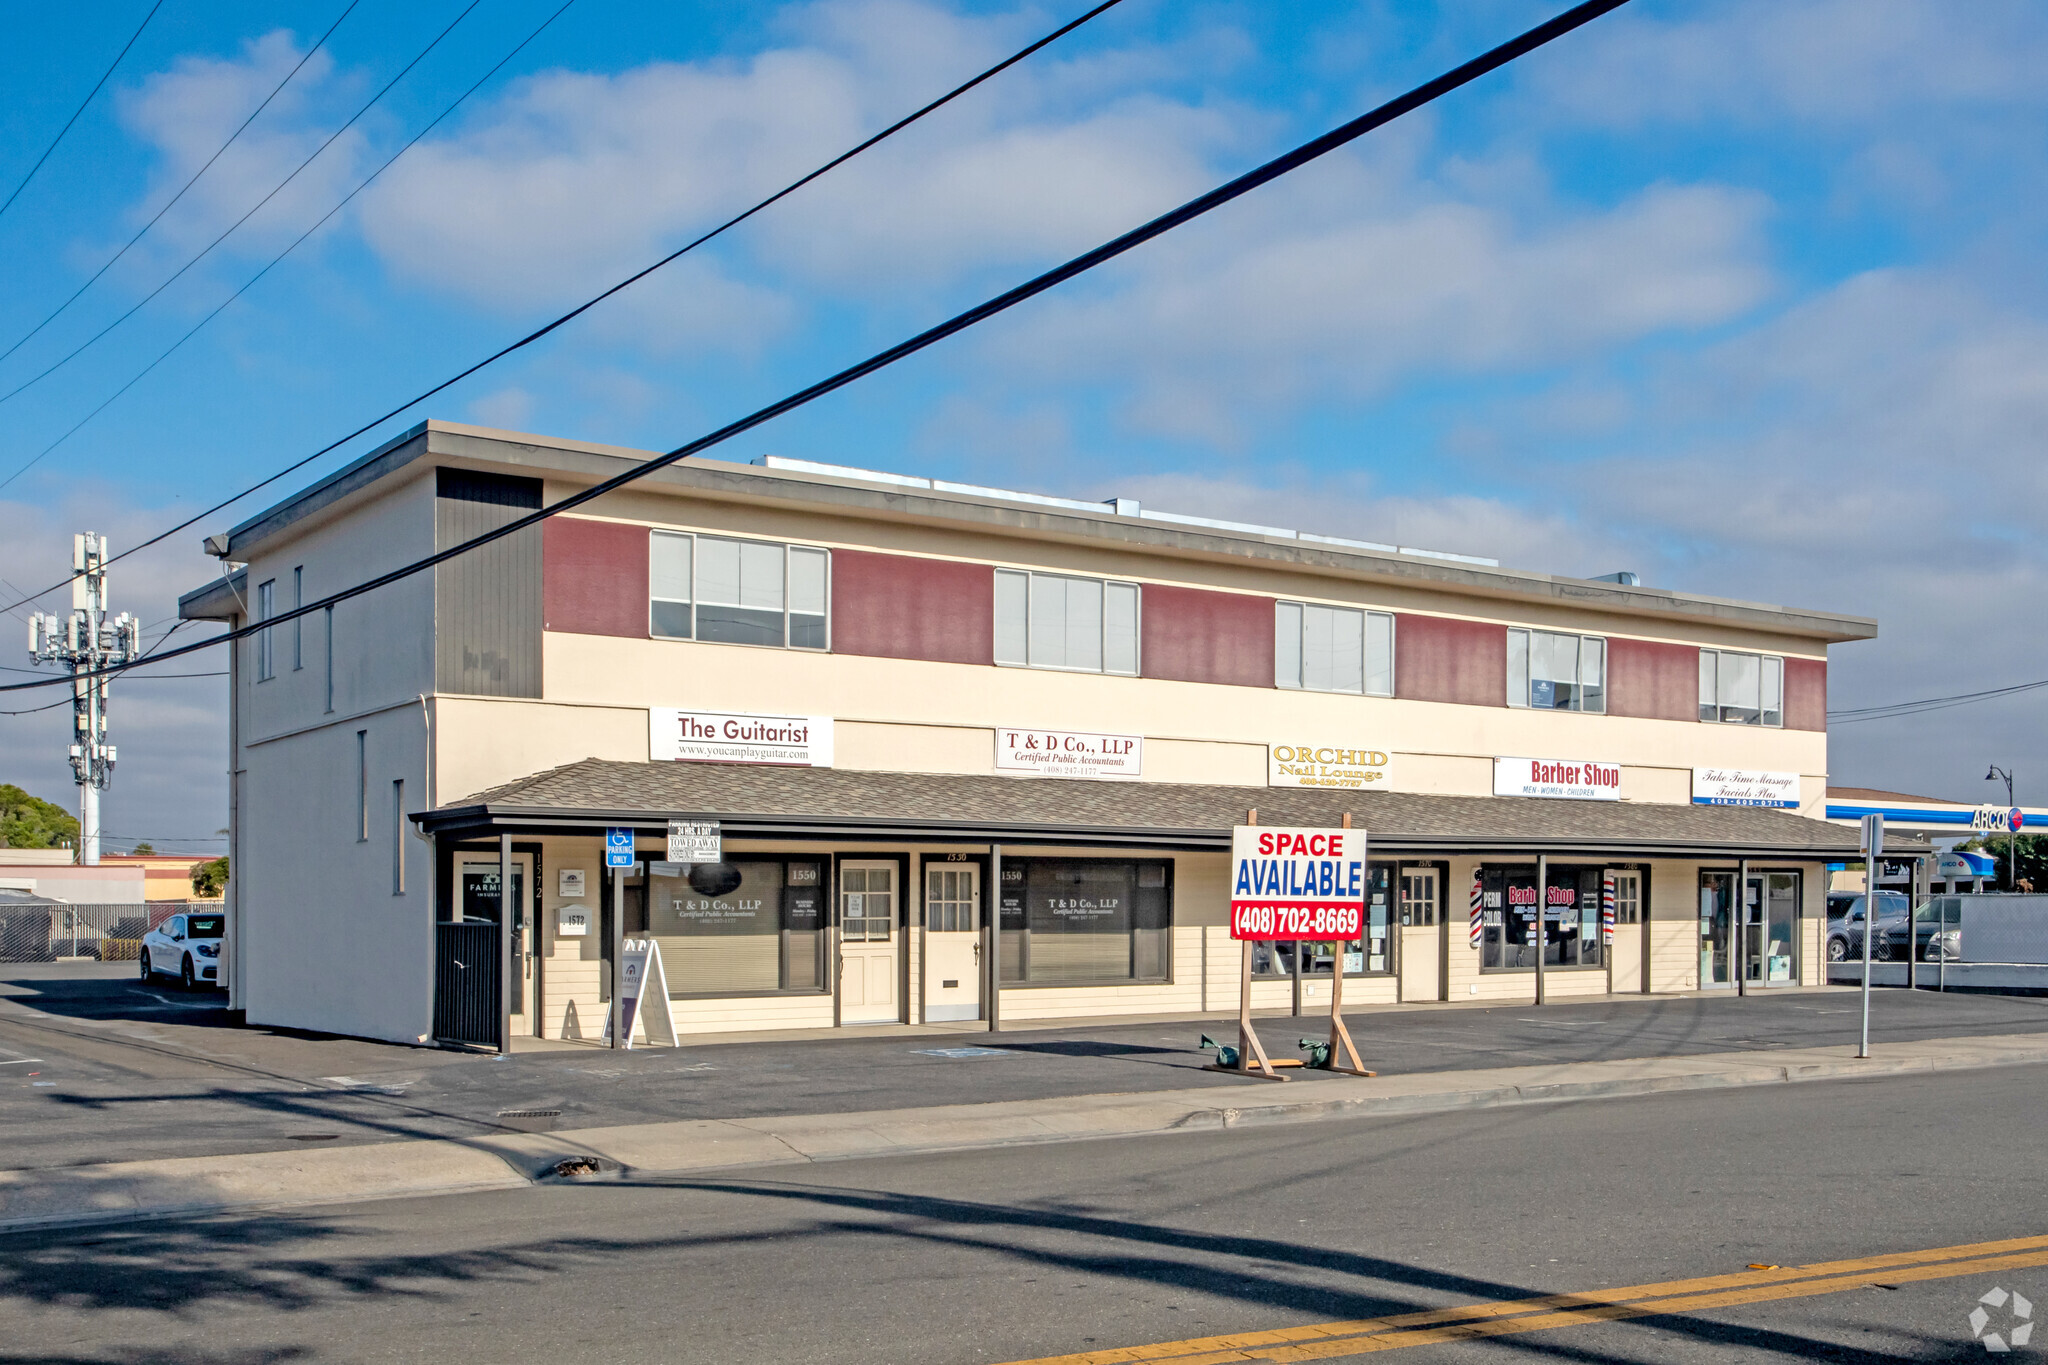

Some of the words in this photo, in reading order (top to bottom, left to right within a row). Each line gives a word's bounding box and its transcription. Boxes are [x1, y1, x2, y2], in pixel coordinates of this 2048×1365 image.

[678, 717, 716, 738] The
[723, 719, 809, 743] Guitarist
[679, 746, 808, 759] www.youcanplayguitar.com
[1006, 732, 1019, 749] T
[1025, 733, 1039, 750] &
[1045, 735, 1058, 751] D
[1063, 736, 1095, 757] Co.,
[1101, 738, 1134, 755] LLP
[1014, 751, 1051, 765] Certified
[1052, 753, 1077, 764] Public
[1078, 755, 1125, 767] Accountants
[1273, 745, 1388, 767] ORCHID
[1043, 765, 1063, 775] (408)
[1064, 766, 1097, 776] 247-1177
[1278, 763, 1316, 777] Nail
[1319, 765, 1383, 783] Lounge
[1531, 760, 1581, 785] Barber
[1583, 763, 1619, 789] Shop
[1702, 769, 1727, 782] Take
[1729, 771, 1755, 784] Time
[1755, 773, 1793, 790] Massage
[1522, 785, 1537, 794] MEN
[1540, 786, 1563, 796] WOMEN
[1566, 787, 1595, 797] CHILDREN
[1715, 784, 1752, 798] Facials
[1754, 786, 1776, 799] Plus
[1971, 809, 2005, 829] ARCO
[608, 845, 633, 854] PARKING
[670, 838, 697, 847] TOWED
[698, 839, 718, 848] AWAY
[1258, 832, 1343, 857] SPACE
[612, 855, 628, 864] ONLY
[793, 870, 816, 880] 1550
[1001, 870, 1022, 880] 1550
[1235, 859, 1362, 896] AVAILABLE
[1483, 892, 1502, 908] PERM
[1547, 886, 1575, 906] Shop
[673, 900, 682, 910] T
[686, 901, 696, 910] &
[700, 900, 709, 910] D
[713, 900, 735, 912] Co.,
[738, 900, 761, 910] LLP
[1048, 899, 1056, 908] T
[1058, 899, 1067, 908] &
[1069, 899, 1077, 908] D
[1080, 899, 1098, 910] Co.,
[1100, 899, 1119, 908] LLP
[568, 915, 585, 926] 1572
[679, 911, 704, 919] Certified
[1235, 906, 1276, 936] (408)
[1277, 907, 1359, 934] 702-8669
[1483, 911, 1502, 927] COLOR
